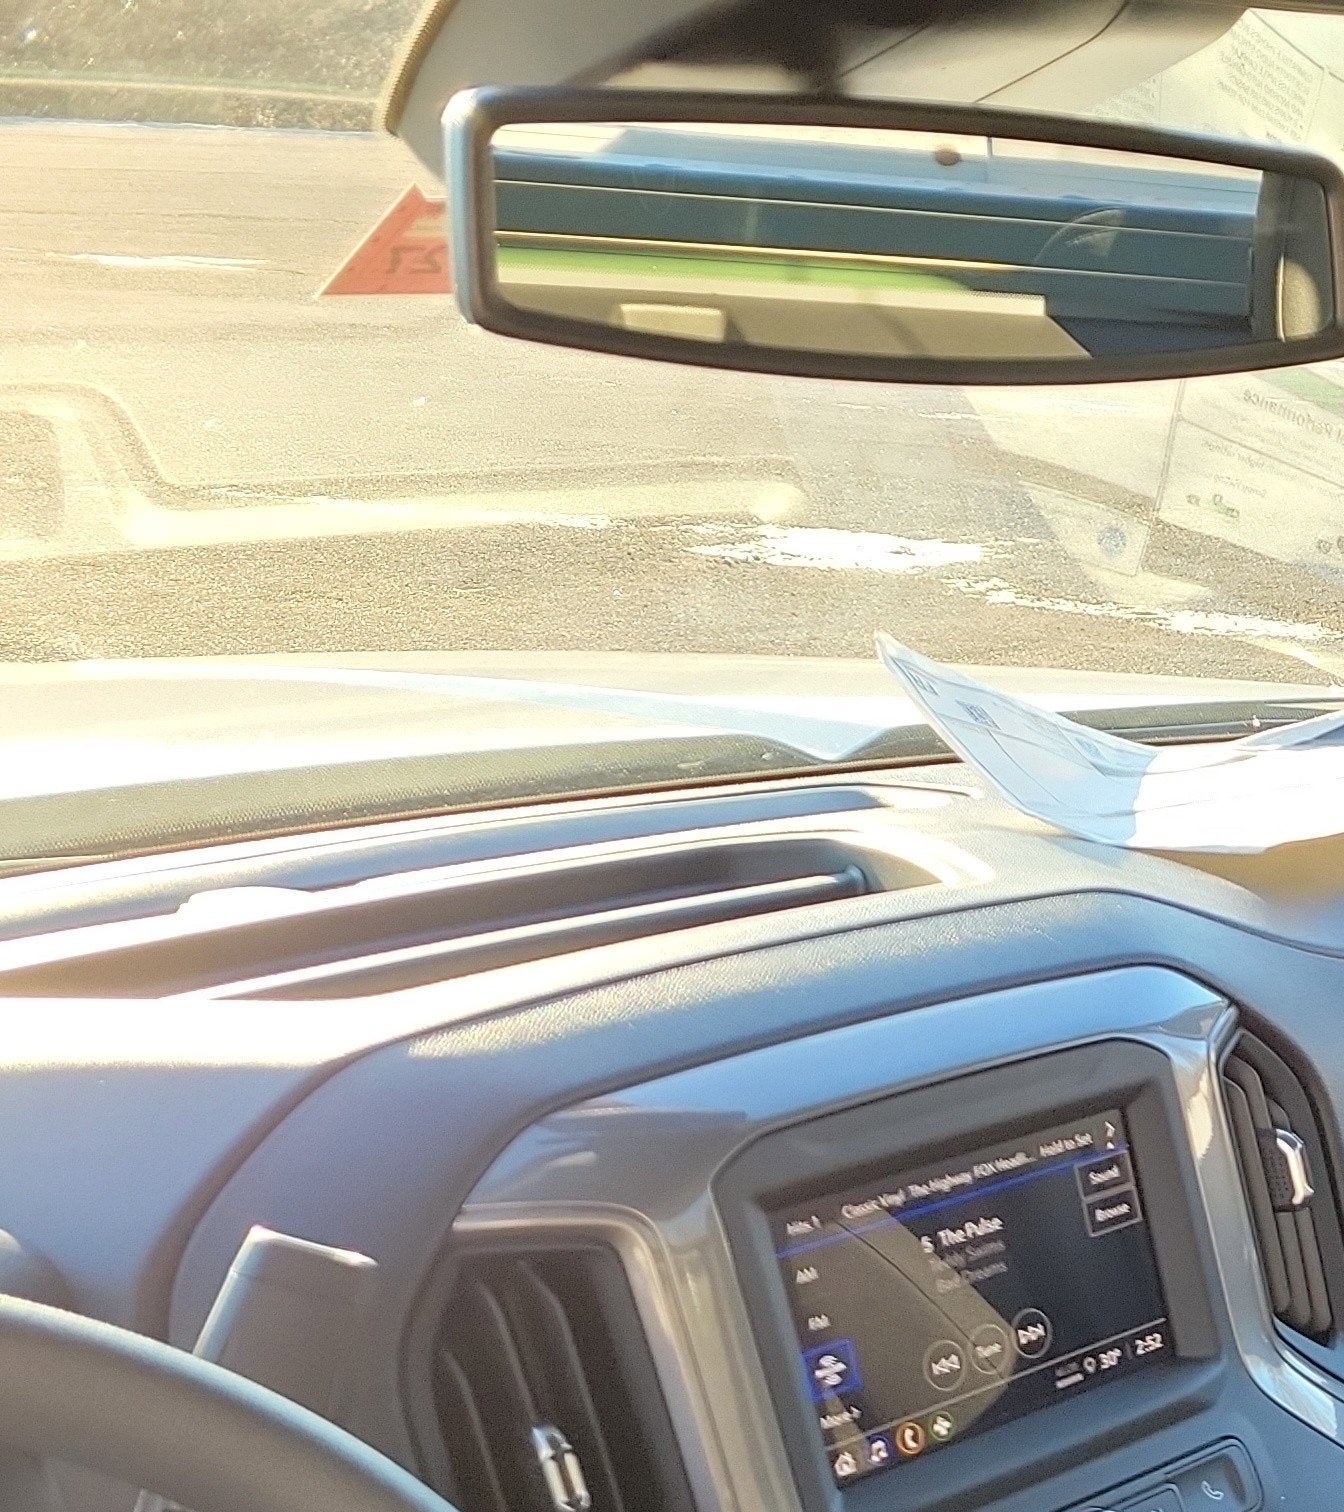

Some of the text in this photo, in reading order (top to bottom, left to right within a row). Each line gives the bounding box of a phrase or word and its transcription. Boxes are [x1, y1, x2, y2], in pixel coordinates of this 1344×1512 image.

[936, 1224, 966, 1247] The
[962, 1212, 1004, 1239] Pulse
[1131, 1331, 1165, 1356] 2:52
